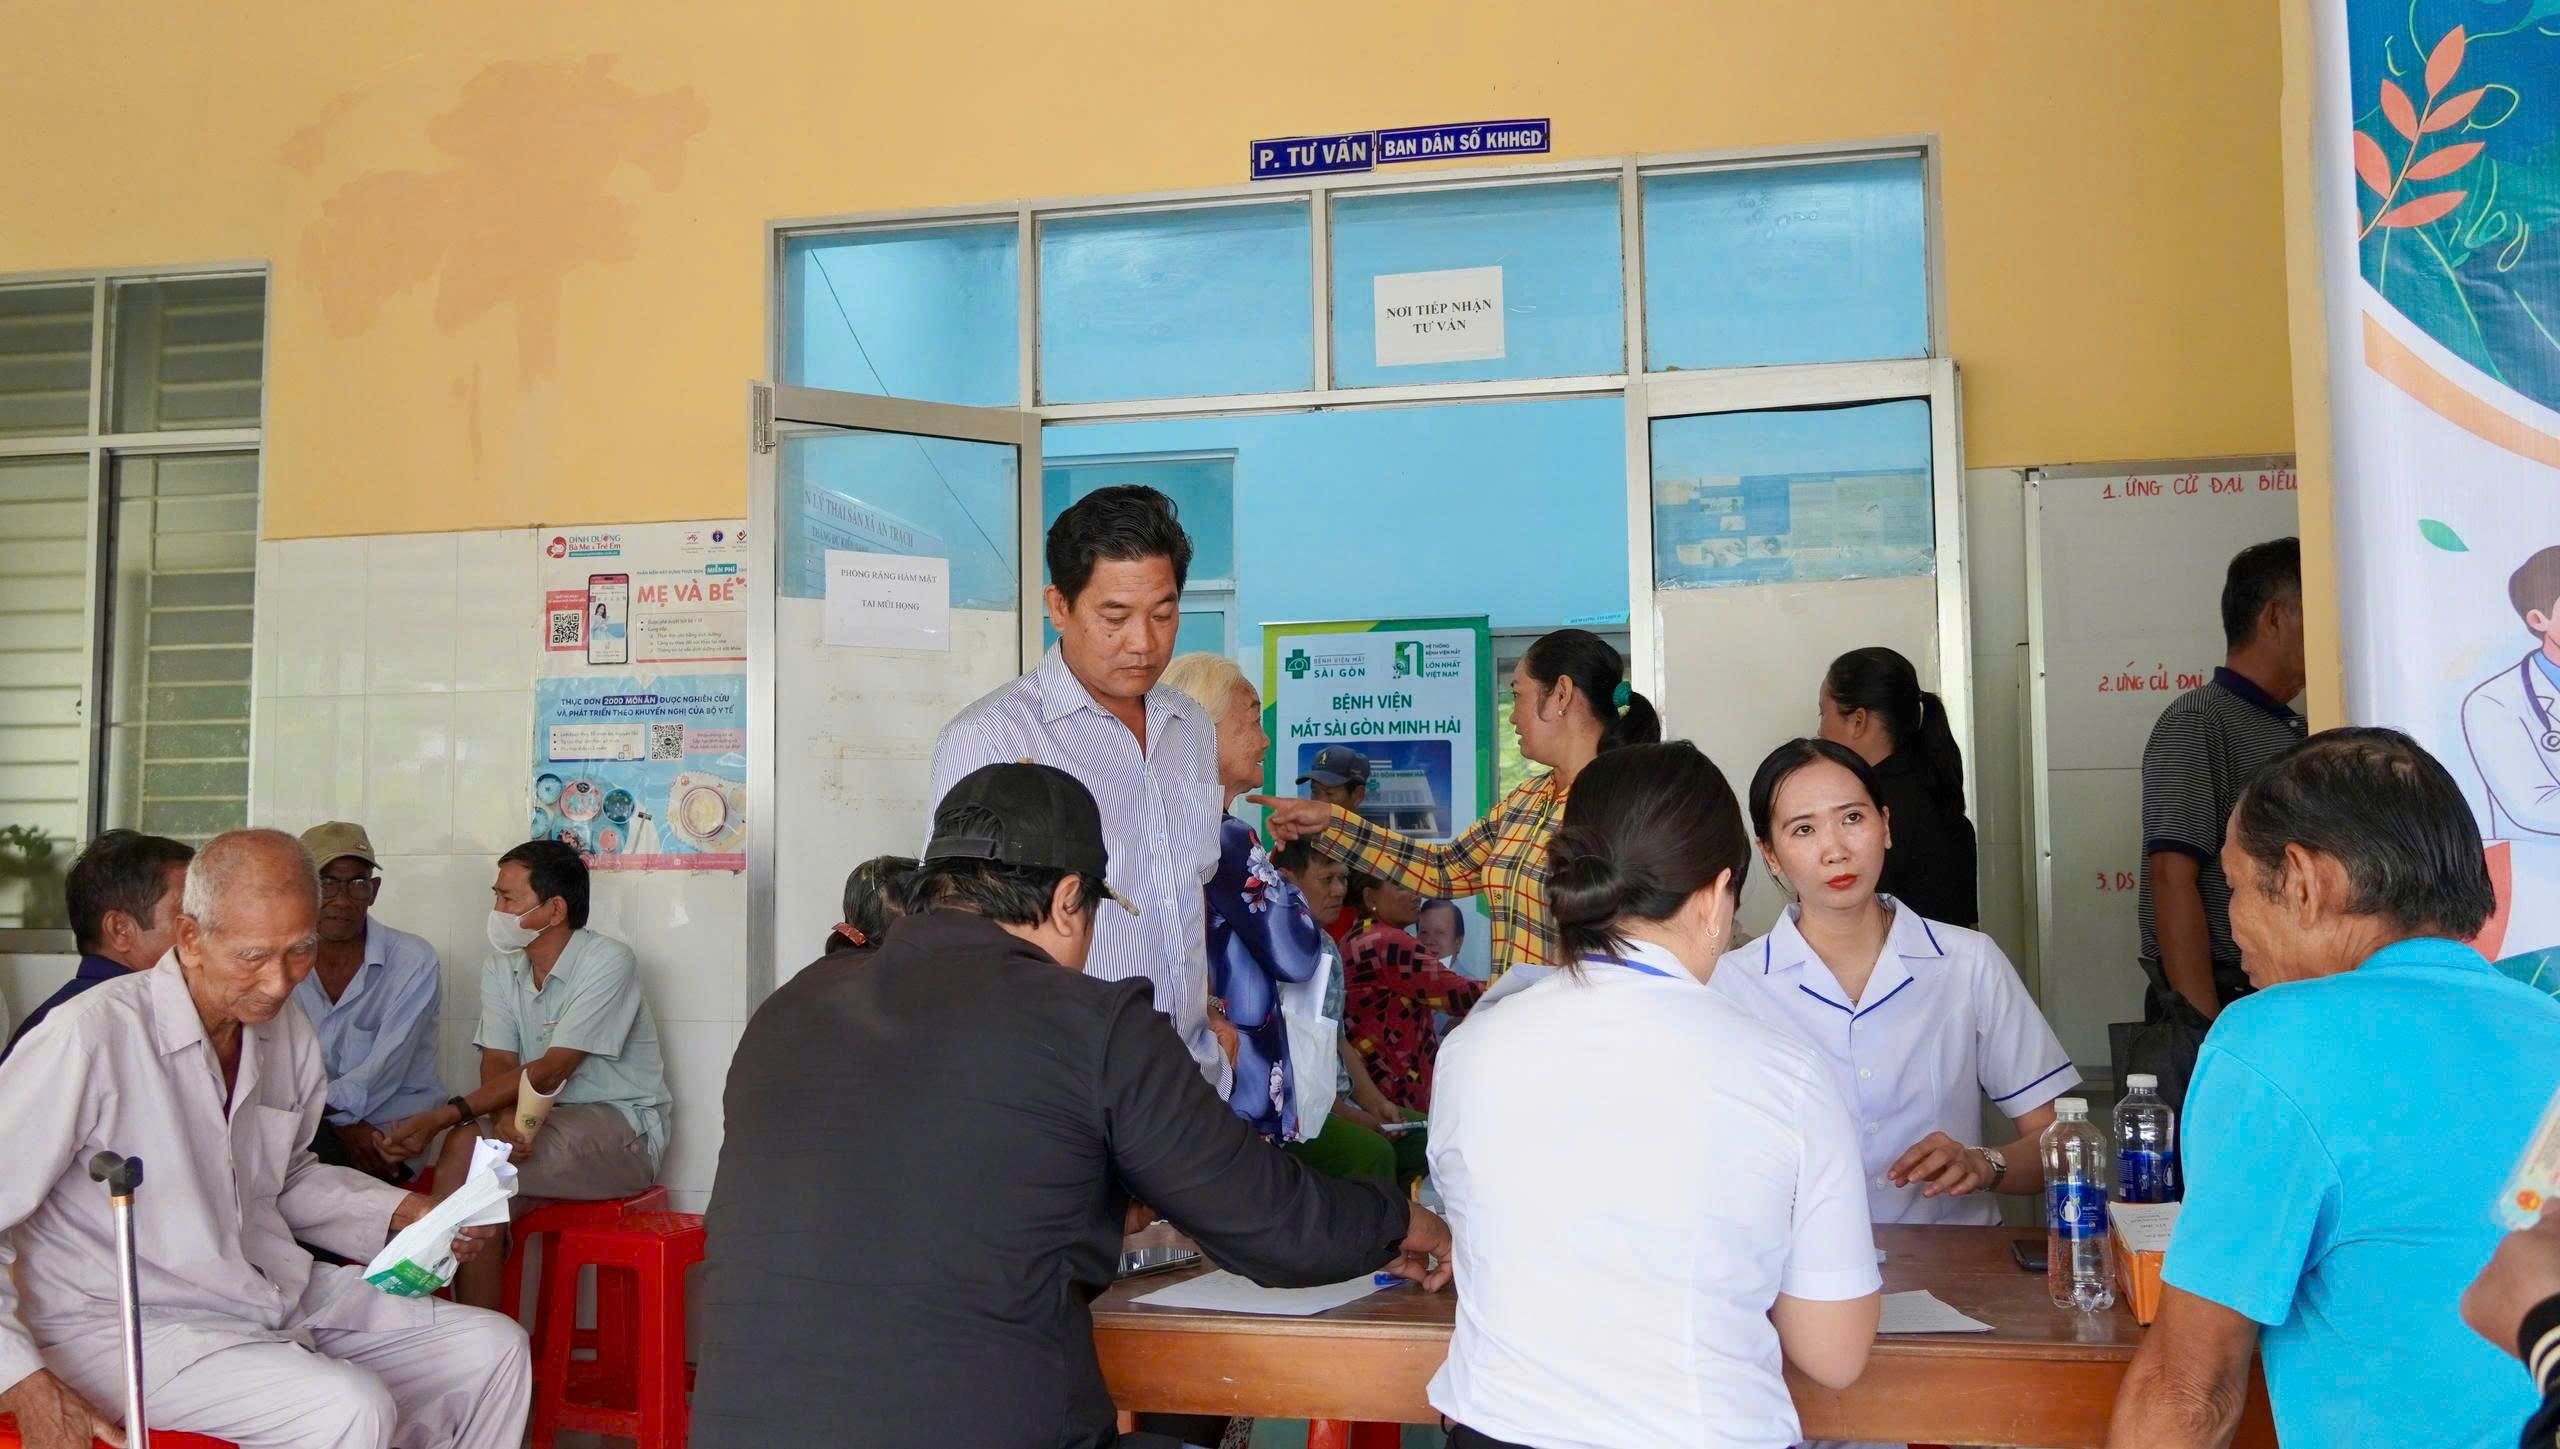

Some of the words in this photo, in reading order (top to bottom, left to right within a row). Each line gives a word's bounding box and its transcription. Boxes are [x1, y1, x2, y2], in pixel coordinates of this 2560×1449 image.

[1385, 139, 1417, 157] BAN
[1422, 132, 1455, 153] DÂN
[1459, 127, 1482, 150] SỐ
[1259, 149, 1280, 169] P.
[1287, 141, 1316, 167] TƯ
[1323, 137, 1366, 163] VẤN
[1387, 305, 1412, 318] NƠI
[1415, 301, 1448, 316] TIẾP
[1452, 298, 1492, 313] NHẬN
[1413, 321, 1434, 334] TƯ
[1437, 317, 1466, 331] VẤN
[2103, 485, 2121, 499] 1.
[637, 584, 668, 607] MẸ
[674, 578, 702, 602] VÀ
[709, 577, 734, 601] BÉ
[1314, 667, 1334, 678] SÀI
[1339, 666, 1366, 677] GÒN
[2099, 676, 2113, 692] 2.
[1332, 692, 1373, 714] BỆNH
[1377, 691, 1412, 713] VIỆN
[1290, 716, 1321, 737] MẮT
[1324, 718, 1347, 737] SÀI
[1350, 717, 1384, 736] GÒN
[1388, 719, 1430, 735] MINH
[1435, 715, 1461, 734] HẢI
